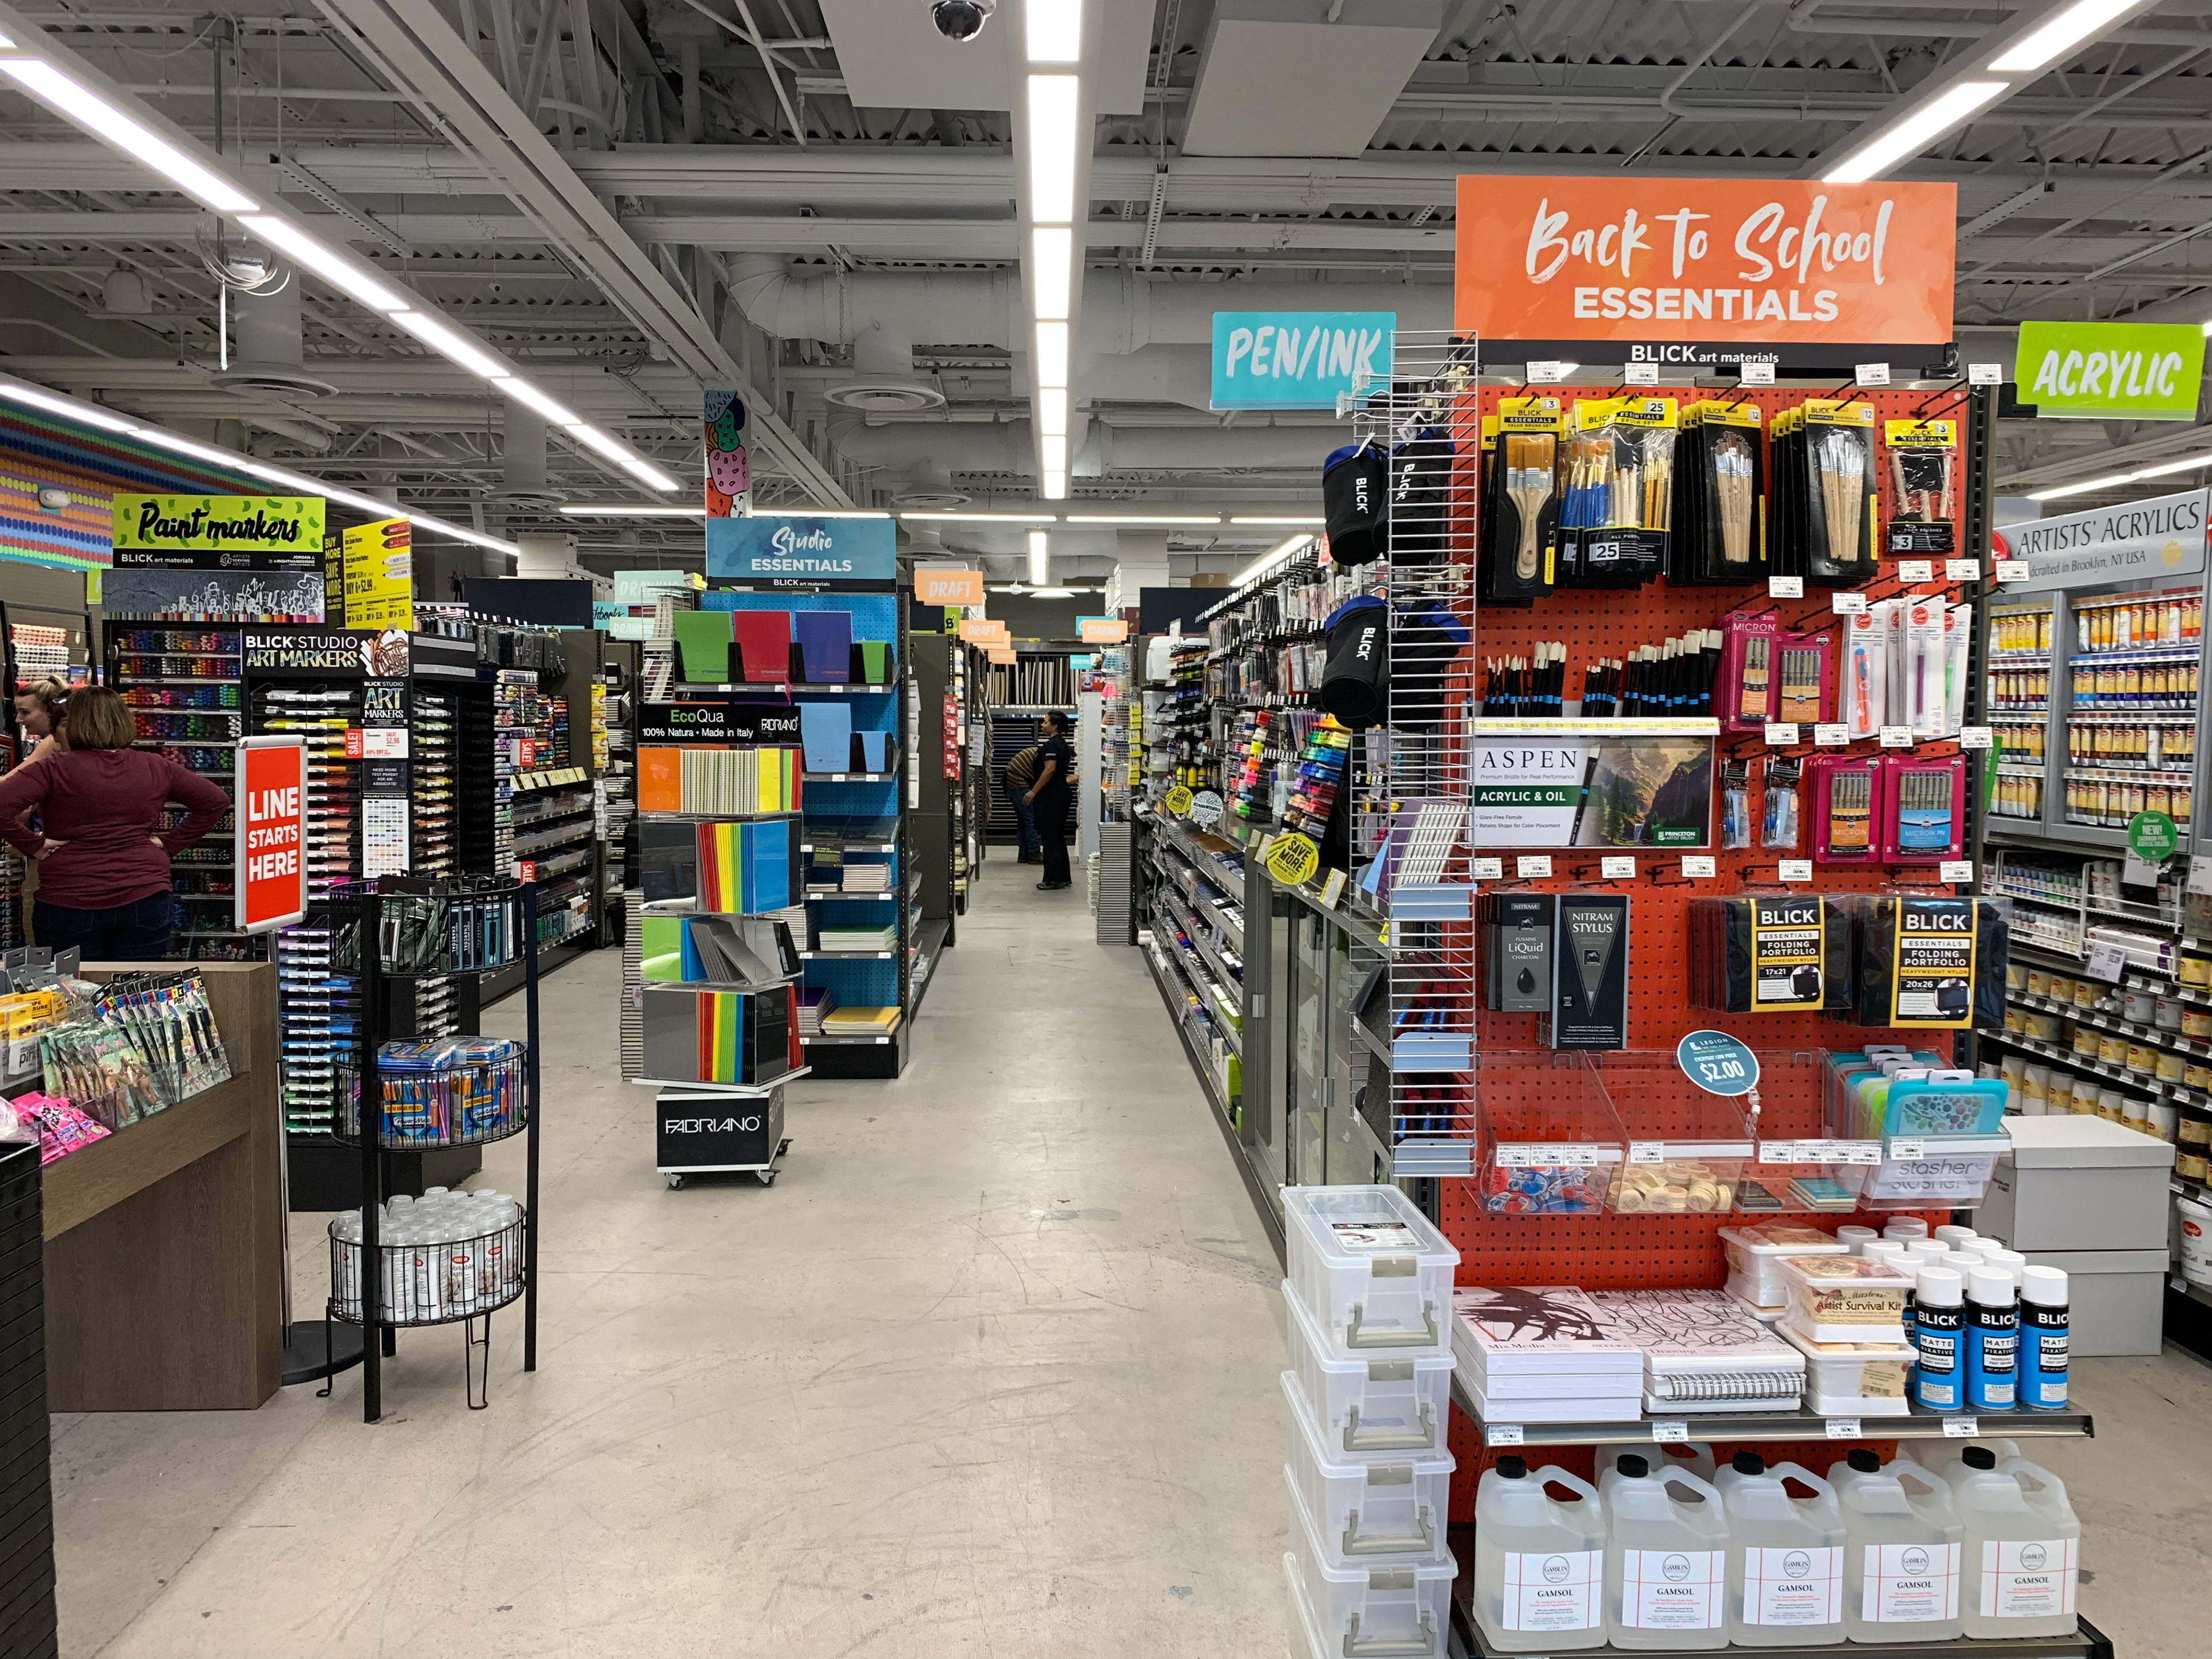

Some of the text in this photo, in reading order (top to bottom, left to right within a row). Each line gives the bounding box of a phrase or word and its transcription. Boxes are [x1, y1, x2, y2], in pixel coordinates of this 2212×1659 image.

[1526, 198, 1653, 284] Back
[1735, 195, 1893, 285] School
[1574, 287, 1839, 321] ESSENTIALS
[1226, 325, 1381, 381] PEN/INK
[1632, 345, 1779, 363] BLICK art materials
[2033, 350, 2182, 399] ACRYLIC
[1650, 403, 1664, 412] 25
[1752, 411, 1759, 419] 12
[1865, 410, 1872, 419] 12
[1940, 424, 1946, 433] 3
[1356, 477, 1368, 511] BLICK
[138, 502, 300, 542] Paint markers
[2017, 502, 2199, 555] ARTISTS' ACRYLICS
[325, 536, 336, 548] BUY
[772, 526, 832, 556] Studio
[1902, 537, 1908, 547] 3
[325, 547, 341, 560] MORE
[1597, 545, 1617, 558] 25
[121, 554, 153, 563] BLICK
[2062, 551, 2146, 574] in Brooklyn, NY USA
[325, 562, 338, 579] SAVE
[751, 559, 852, 572] ESSENTIALS
[326, 579, 342, 596] MORE
[929, 581, 972, 598] DRAFT
[968, 625, 997, 636] DRAFT
[1733, 623, 1775, 631] MICRON
[245, 636, 357, 649] BLICK STUDIO
[1356, 627, 1376, 659] BLICK
[247, 650, 357, 668] ART MARKERS
[364, 688, 404, 709] ART
[365, 710, 404, 718] MARKERS
[671, 709, 724, 723] EcoQua
[762, 718, 797, 731] FABRIANO
[642, 728, 753, 738] 100% Natura Made in Italy
[347, 732, 358, 755] SALE!
[521, 741, 532, 763] SALE!
[1481, 751, 1577, 768] ASPEN
[1480, 791, 1566, 801] ACRYLIC & OIL
[248, 787, 298, 822] LINE
[248, 824, 298, 849] STARTS
[2142, 825, 2163, 835] NEW!
[1293, 835, 1302, 843] BUY
[1287, 840, 1311, 862] SAVE
[249, 850, 298, 882] HERE
[1278, 849, 1305, 873] MORE
[1573, 912, 1613, 921] NITRAM
[1761, 909, 1816, 925] BLICK
[1906, 914, 1967, 930] BLICK
[1573, 923, 1612, 933] STYLUS
[1508, 943, 1543, 953] LiQuid
[1767, 941, 1809, 949] FOLDING
[1762, 948, 1816, 956] PORTFOLIO
[1911, 950, 1959, 958] FOLDING
[1904, 958, 1967, 966] PORTFOLIO
[1906, 980, 1933, 988] 20x26
[174, 996, 184, 1005] Pen
[1700, 1060, 1745, 1083] $2.00
[665, 1116, 759, 1134] FABRIANO
[1899, 1157, 1973, 1175] stasher
[1817, 1301, 1902, 1310] Artist Survival Kit
[1918, 1311, 1957, 1325] BLICK
[1922, 1337, 1952, 1347] MATTE
[1921, 1346, 1953, 1355] FIXATIVE
